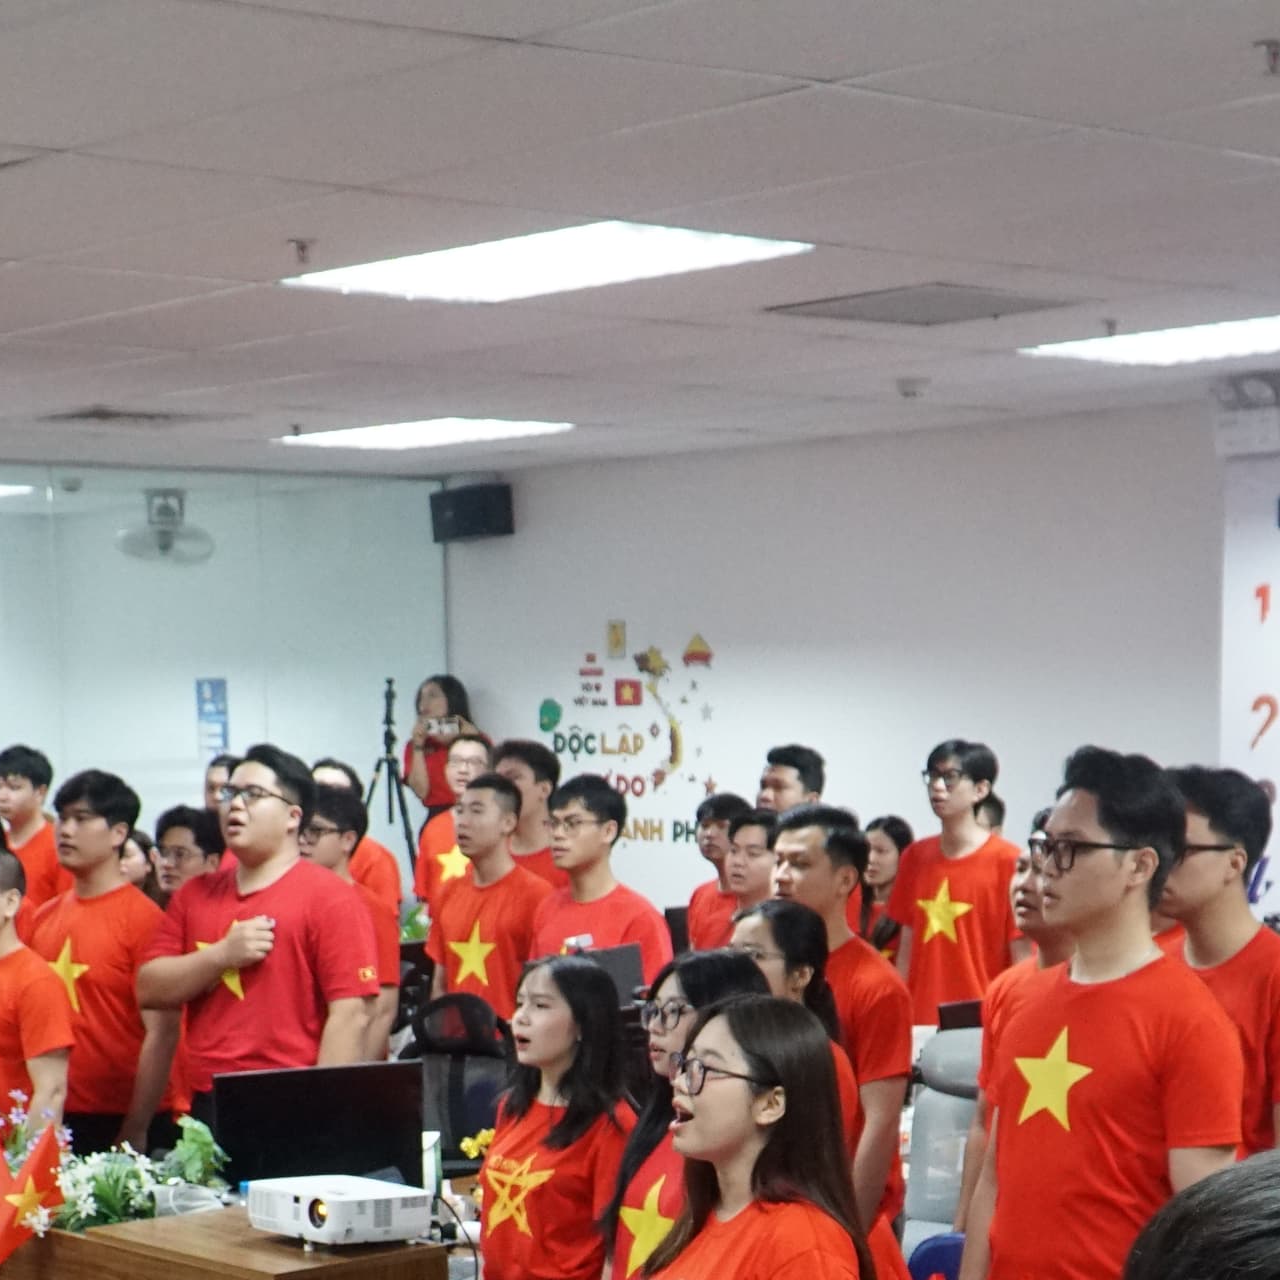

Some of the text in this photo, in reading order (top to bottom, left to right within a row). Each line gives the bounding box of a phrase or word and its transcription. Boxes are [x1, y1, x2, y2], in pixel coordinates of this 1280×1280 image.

[1255, 584, 1271, 624] 1
[600, 723, 645, 762] LẬP
[672, 820, 699, 843] PH
